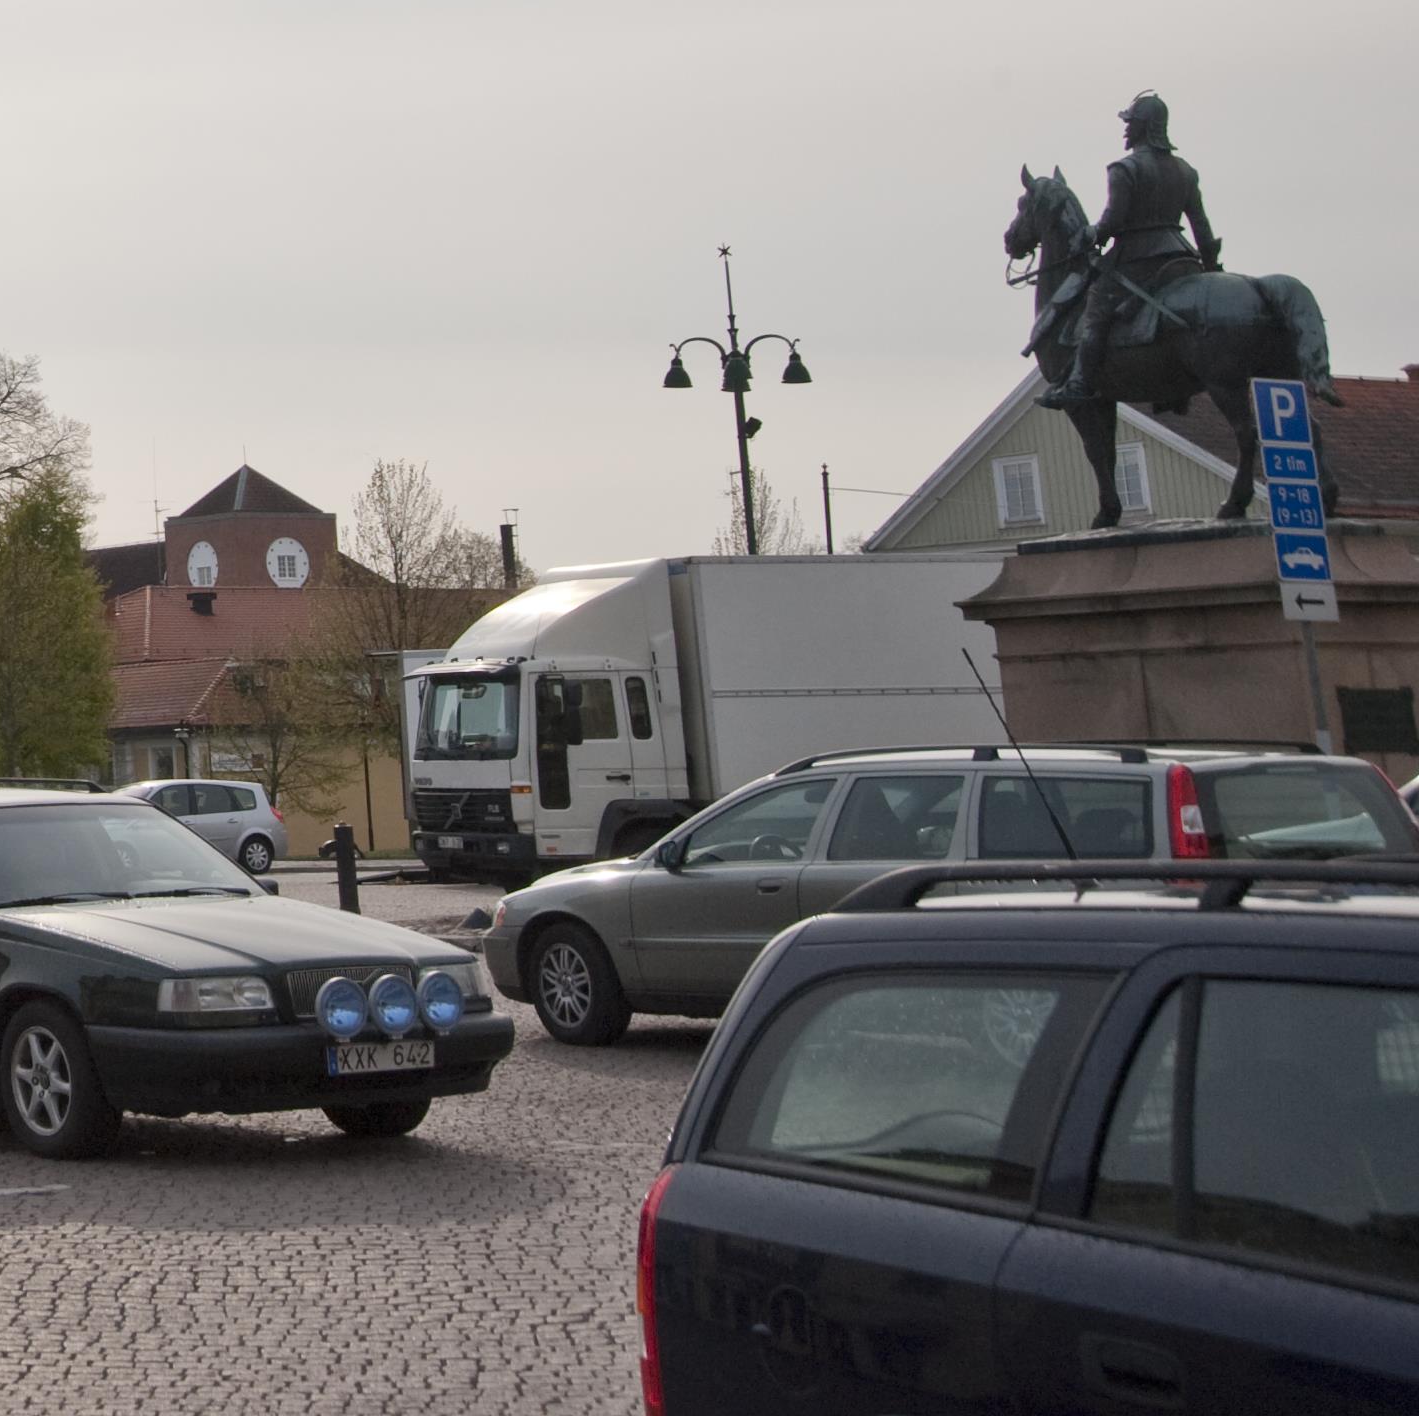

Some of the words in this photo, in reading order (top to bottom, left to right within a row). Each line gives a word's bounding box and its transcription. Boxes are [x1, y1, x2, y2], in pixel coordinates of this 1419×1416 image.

[1269, 387, 1296, 437] P
[1273, 454, 1283, 471] 2
[1286, 455, 1307, 472] tim
[1278, 486, 1311, 504] 9-18
[1277, 506, 1318, 526] (9-13)
[341, 1046, 378, 1071] XXK
[393, 1043, 430, 1066] 642
